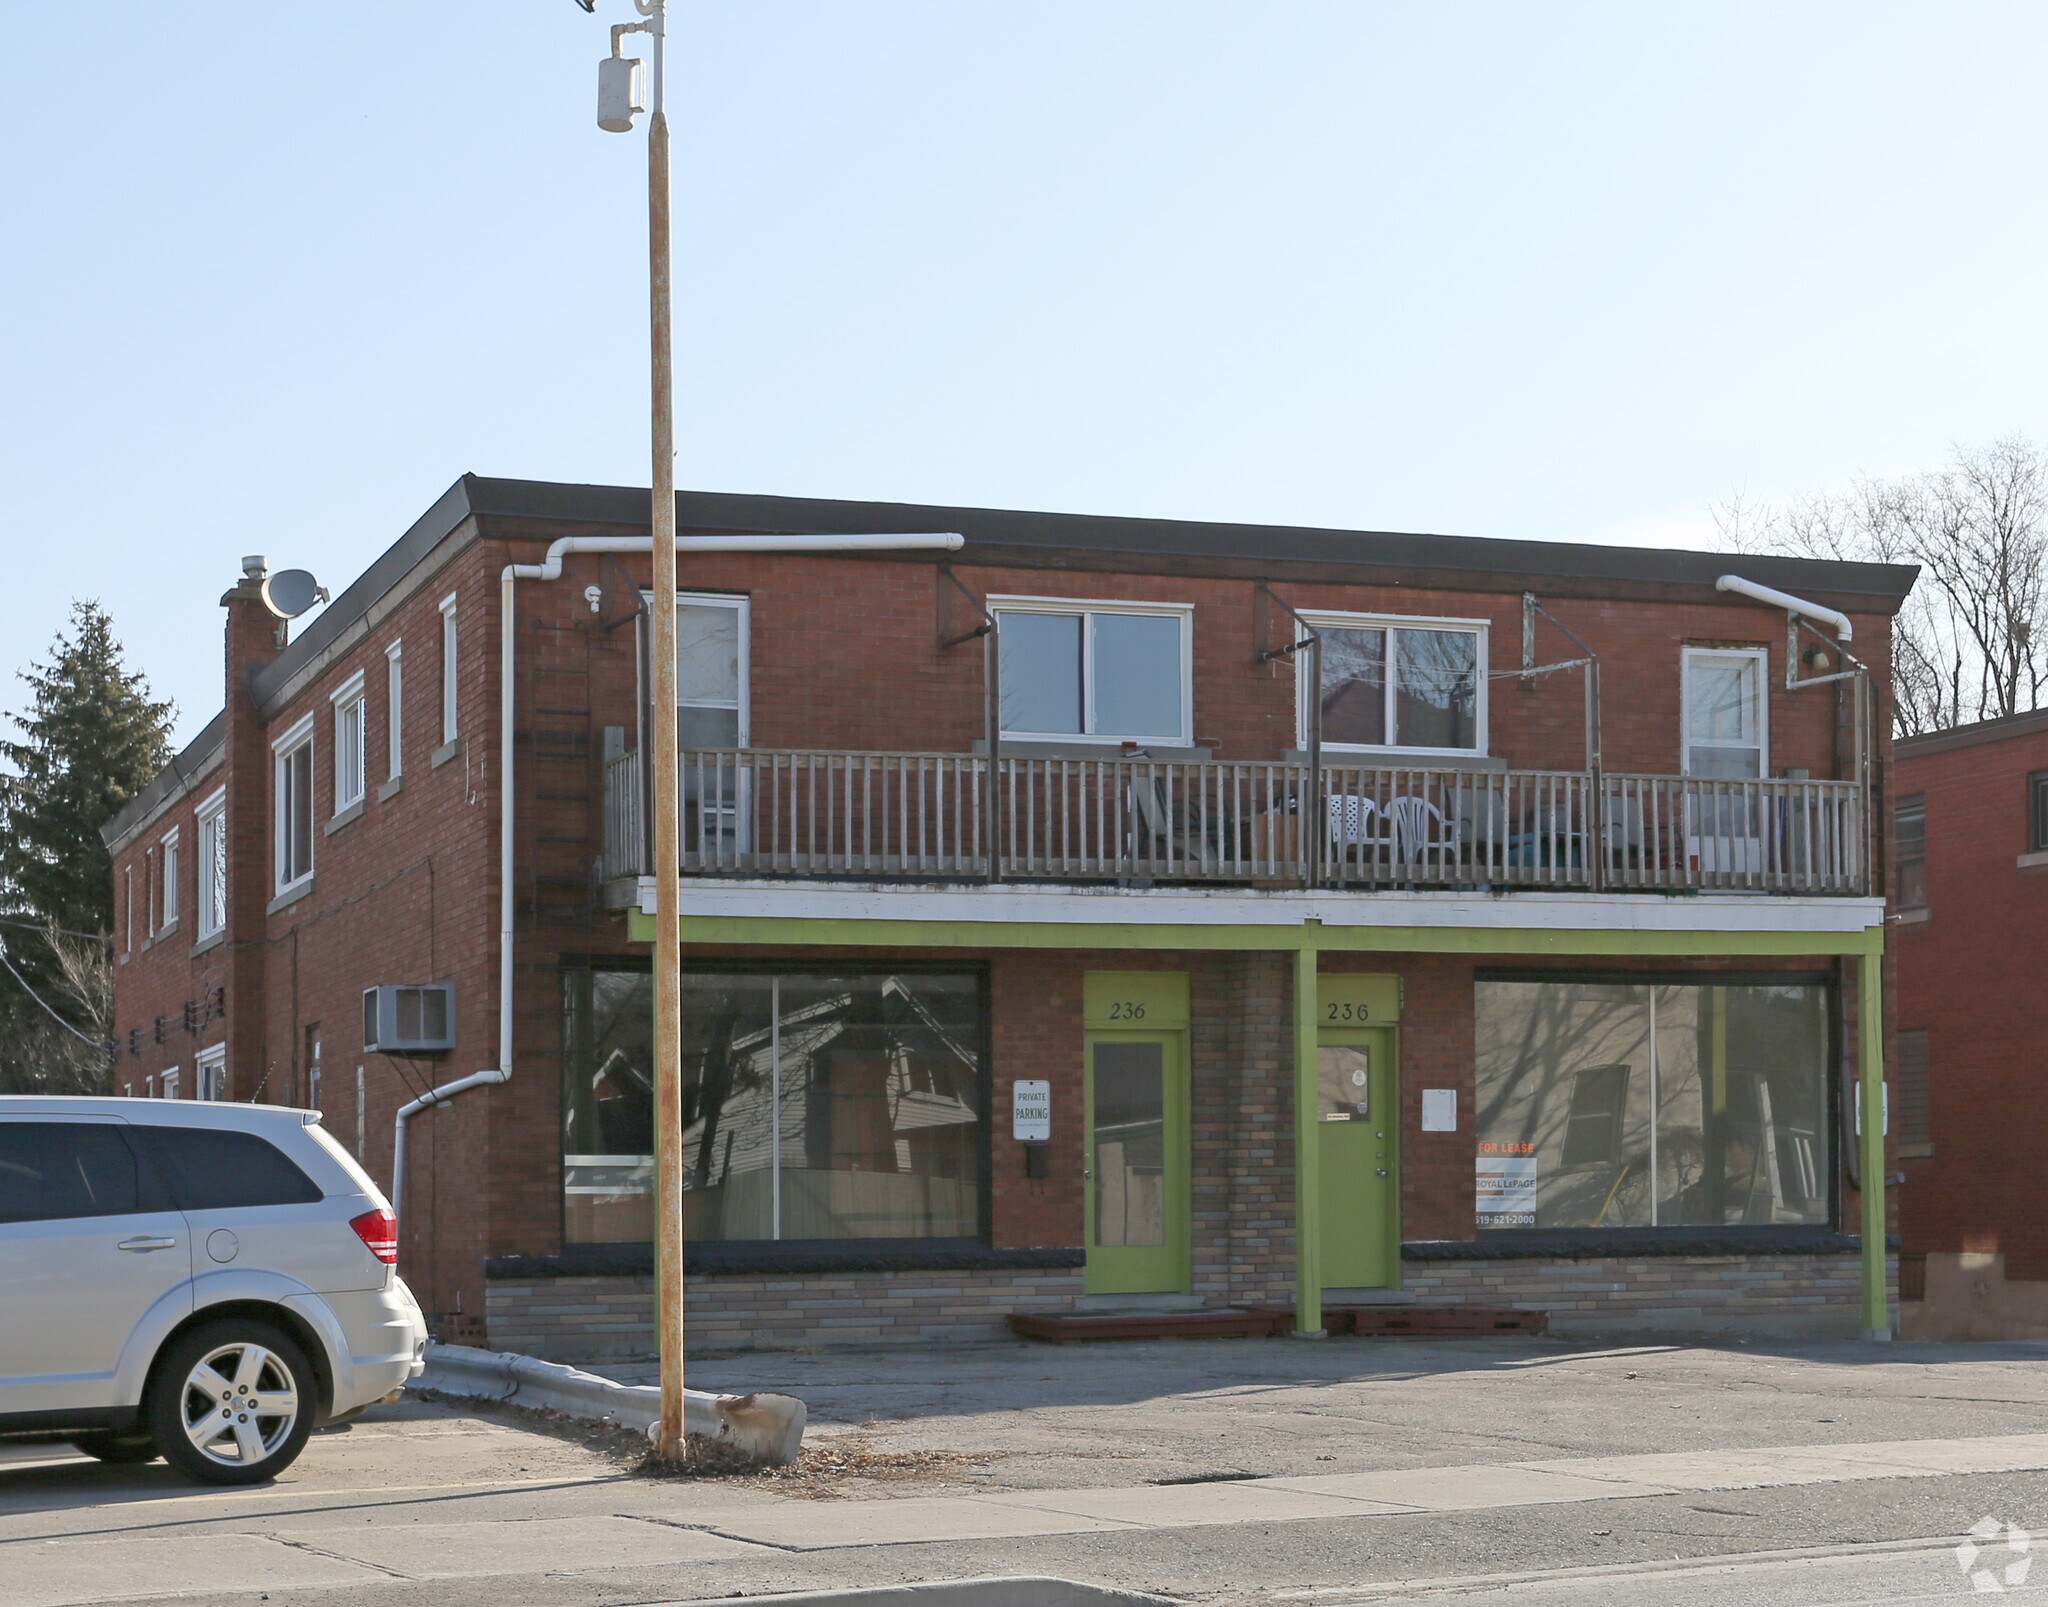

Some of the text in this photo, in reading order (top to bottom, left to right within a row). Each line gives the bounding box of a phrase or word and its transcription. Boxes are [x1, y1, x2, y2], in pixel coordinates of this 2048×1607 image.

[1109, 1002, 1146, 1020] 236
[1327, 1002, 1369, 1021] 236
[1018, 1092, 1047, 1101] PRIVATE
[1015, 1107, 1048, 1120] PARKING
[1478, 1143, 1535, 1153] FOR LEASE
